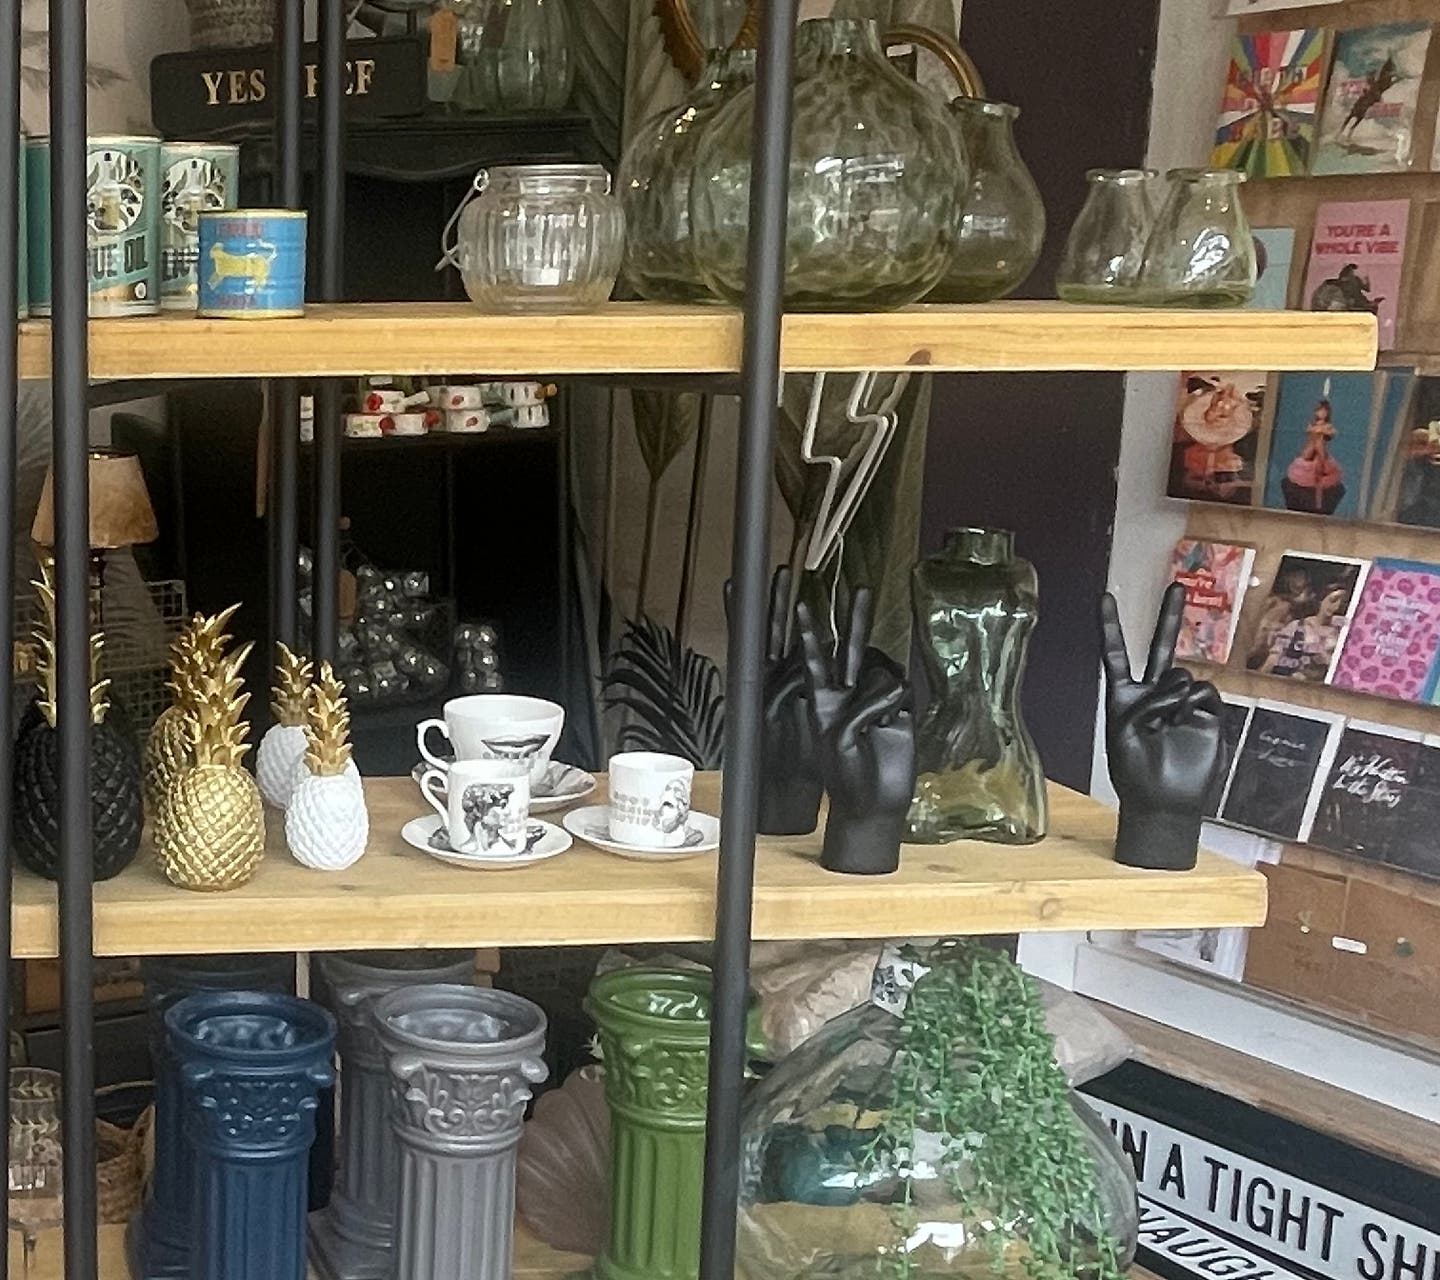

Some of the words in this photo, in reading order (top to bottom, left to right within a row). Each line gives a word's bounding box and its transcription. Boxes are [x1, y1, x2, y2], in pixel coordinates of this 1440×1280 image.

[201, 68, 267, 106] YES
[1316, 241, 1362, 255] WHOLE
[1366, 240, 1400, 255] VIBE
[1325, 224, 1375, 238] YOU'RE
[1378, 223, 1391, 237] A
[123, 234, 149, 274] OIL
[1159, 1143, 1186, 1200] A
[1203, 1155, 1345, 1263] TIGHT
